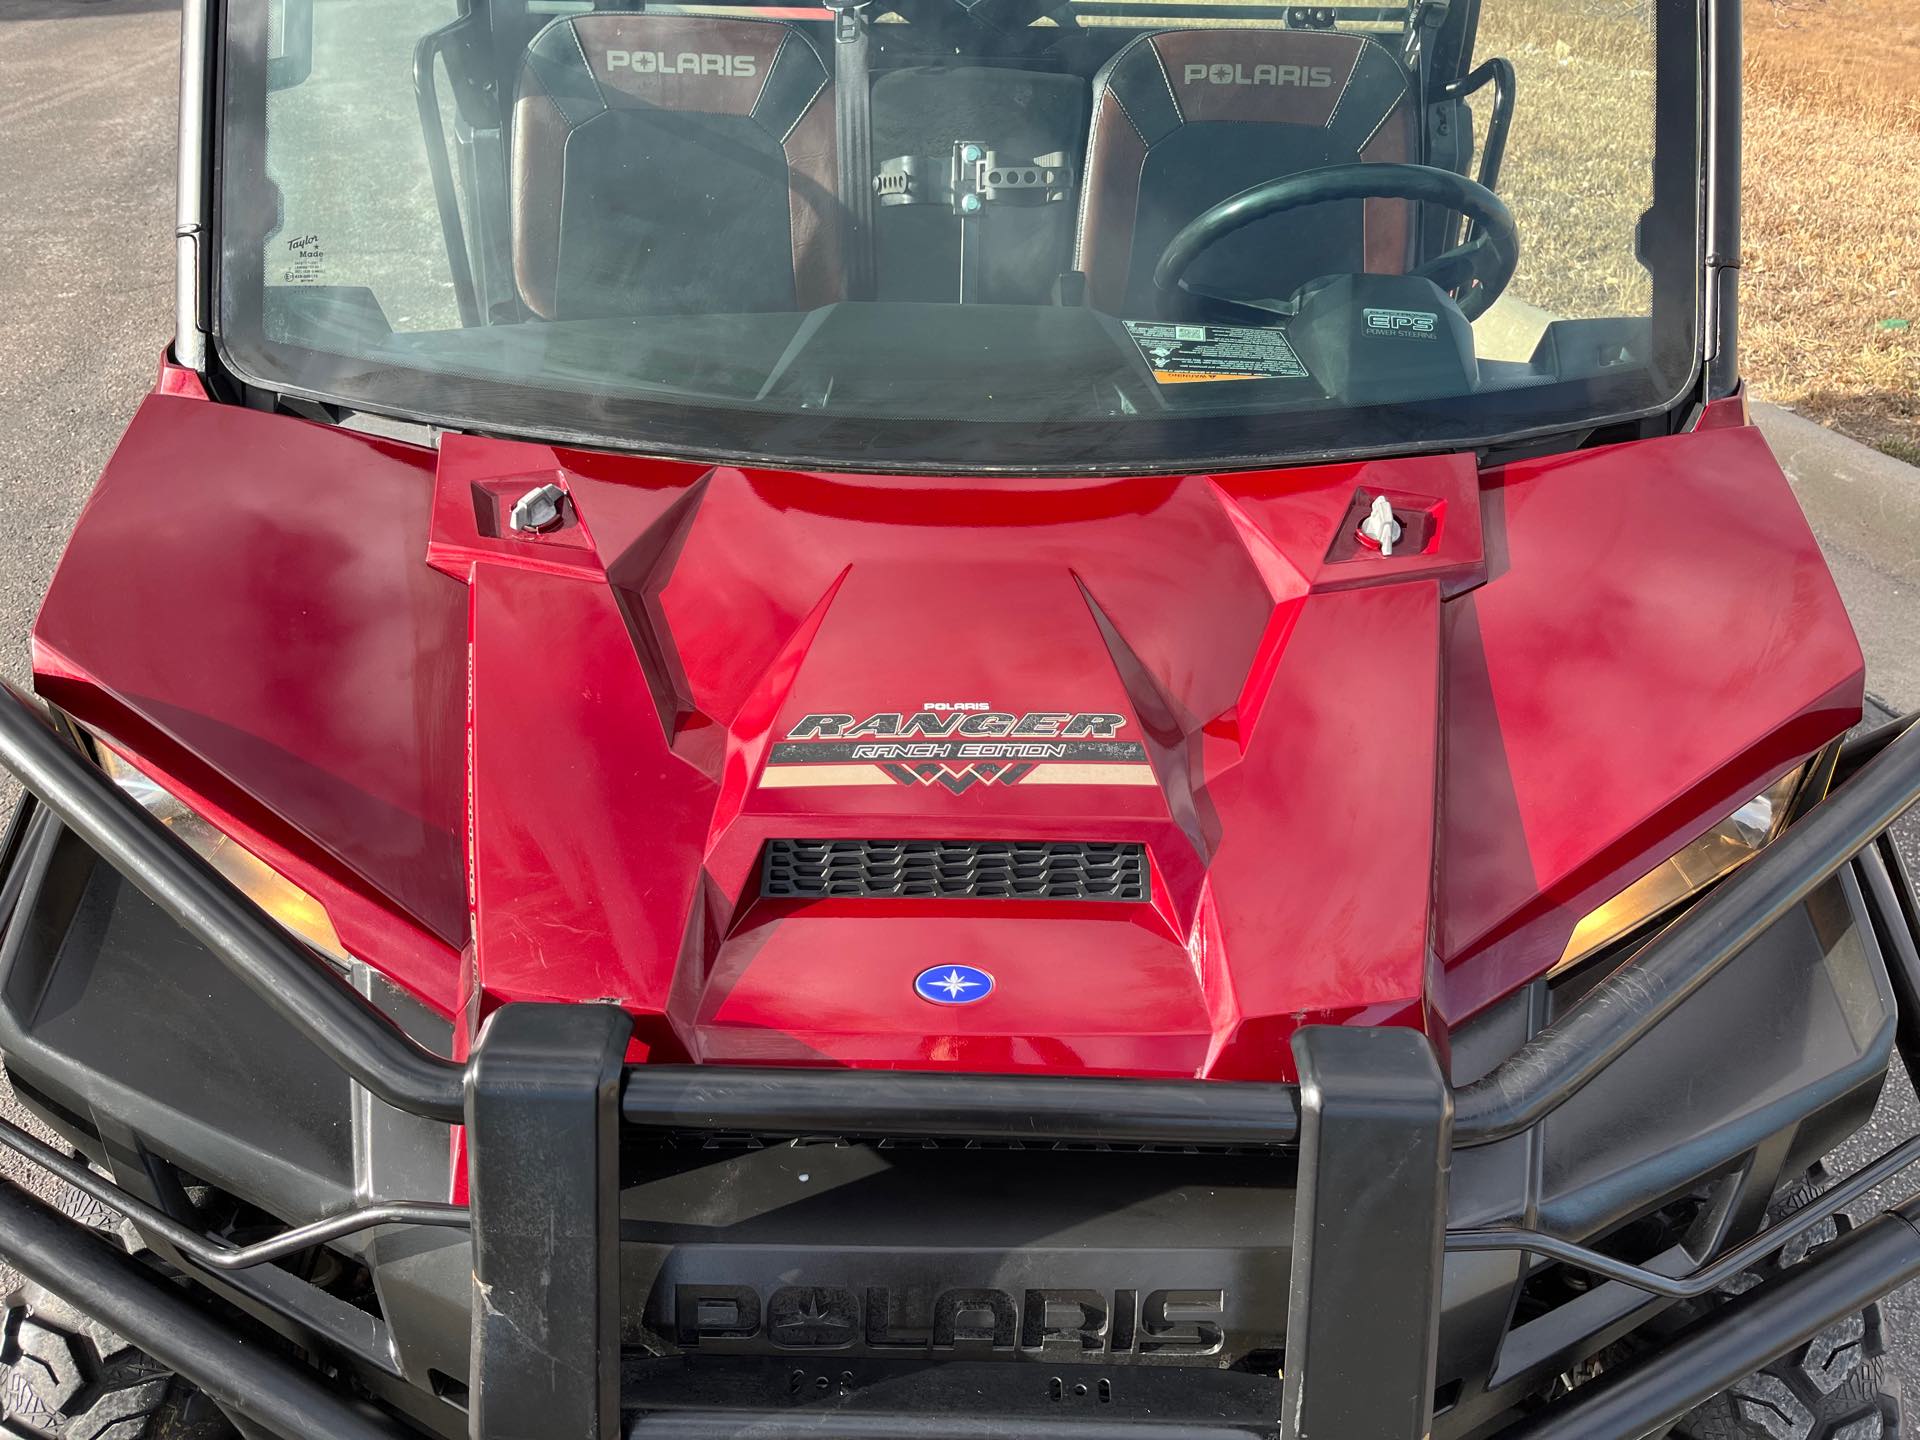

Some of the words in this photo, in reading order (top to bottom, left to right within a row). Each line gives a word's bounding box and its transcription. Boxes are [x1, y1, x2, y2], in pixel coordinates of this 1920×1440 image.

[607, 50, 757, 77] POLARIS
[1184, 64, 1332, 88] POLARIS
[287, 235, 319, 251] Taylor
[299, 250, 324, 258] Made
[1367, 314, 1434, 332] EPS
[1366, 328, 1396, 336] POWER
[1397, 330, 1437, 340] STEERING
[924, 702, 990, 711] POLARIS
[785, 712, 1127, 740] RANGER
[852, 744, 952, 758] RANCH
[957, 743, 1067, 758] EDITION
[673, 1283, 1226, 1356] POLARIS
